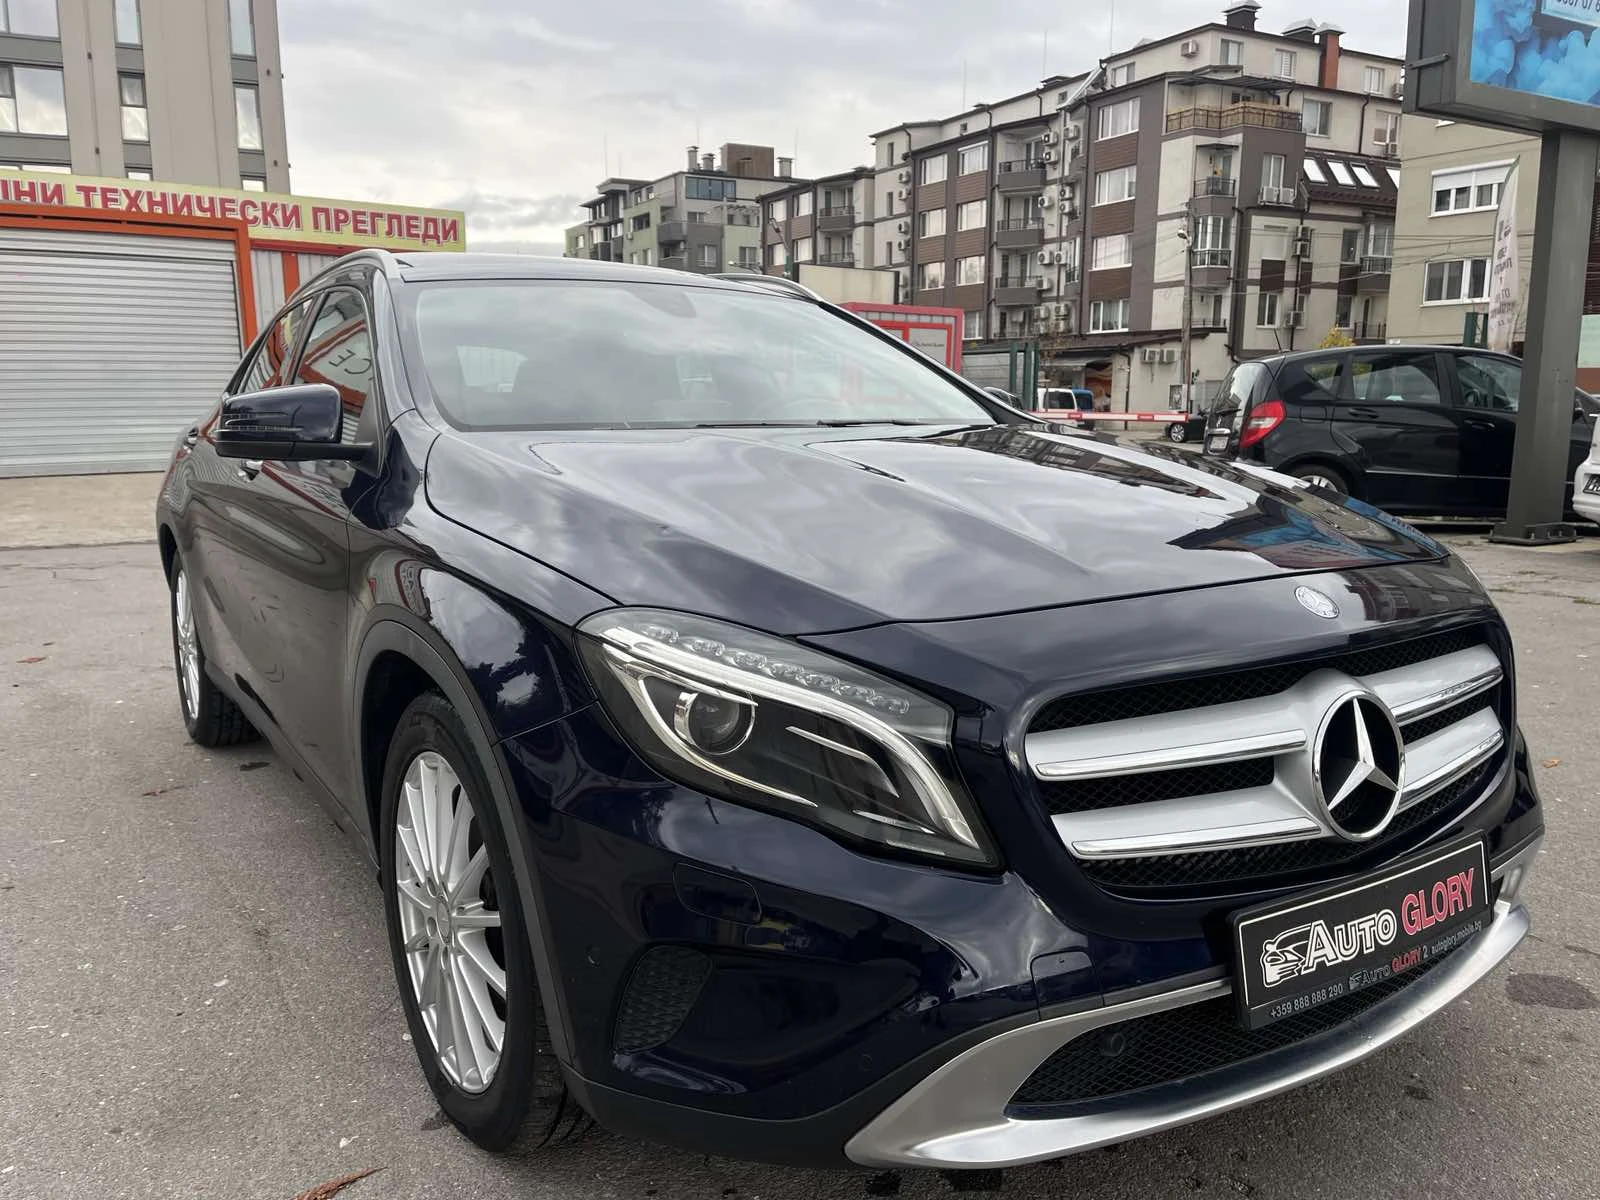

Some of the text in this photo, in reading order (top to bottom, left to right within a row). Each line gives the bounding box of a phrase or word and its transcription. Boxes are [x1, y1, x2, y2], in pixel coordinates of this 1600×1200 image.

[75, 185, 303, 230] ТЕХНИЧЕСКИ
[312, 206, 459, 245] ПРЕГЛЕДИ
[1402, 868, 1474, 936] GLORY
[1392, 948, 1421, 973] GLORY
[1423, 945, 1429, 958] 2
[1270, 983, 1343, 1018] +359 888 888 290
